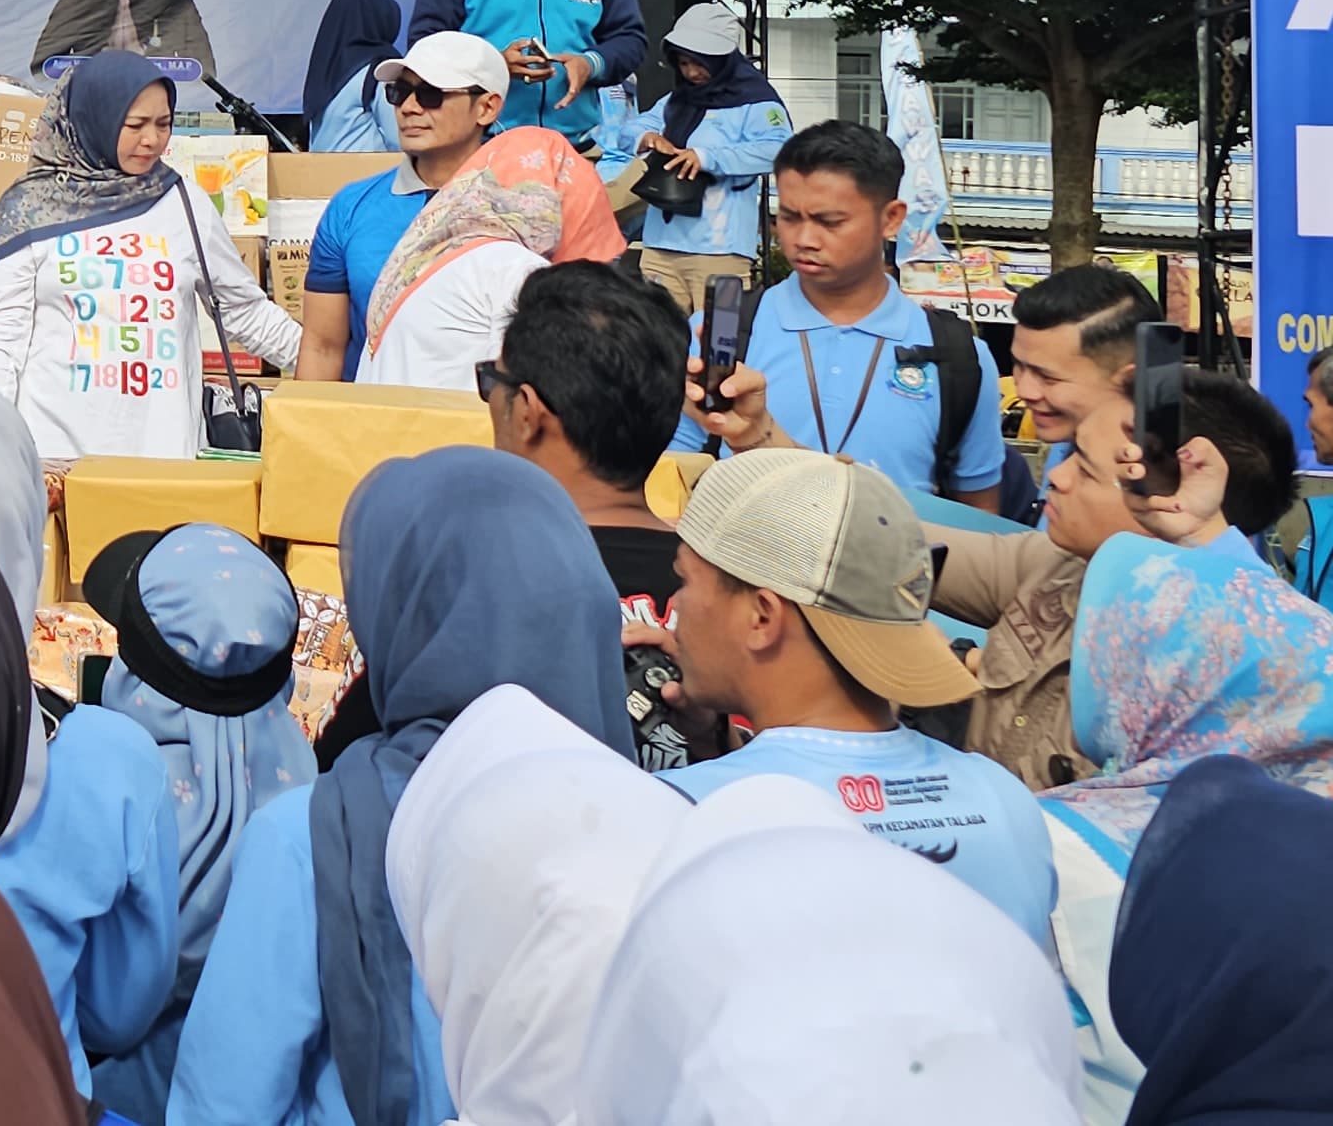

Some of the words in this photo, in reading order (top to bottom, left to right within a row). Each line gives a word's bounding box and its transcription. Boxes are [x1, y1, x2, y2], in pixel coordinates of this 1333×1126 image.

[57, 233, 79, 257] 0
[96, 236, 114, 255] 2
[119, 234, 143, 258] 3
[145, 234, 169, 257] 4
[59, 261, 77, 284] 5
[80, 257, 103, 289] 6
[105, 258, 124, 289] 7
[127, 263, 150, 285] 8
[153, 260, 174, 291] 9
[121, 361, 148, 396] 19
[151, 368, 178, 389] 20
